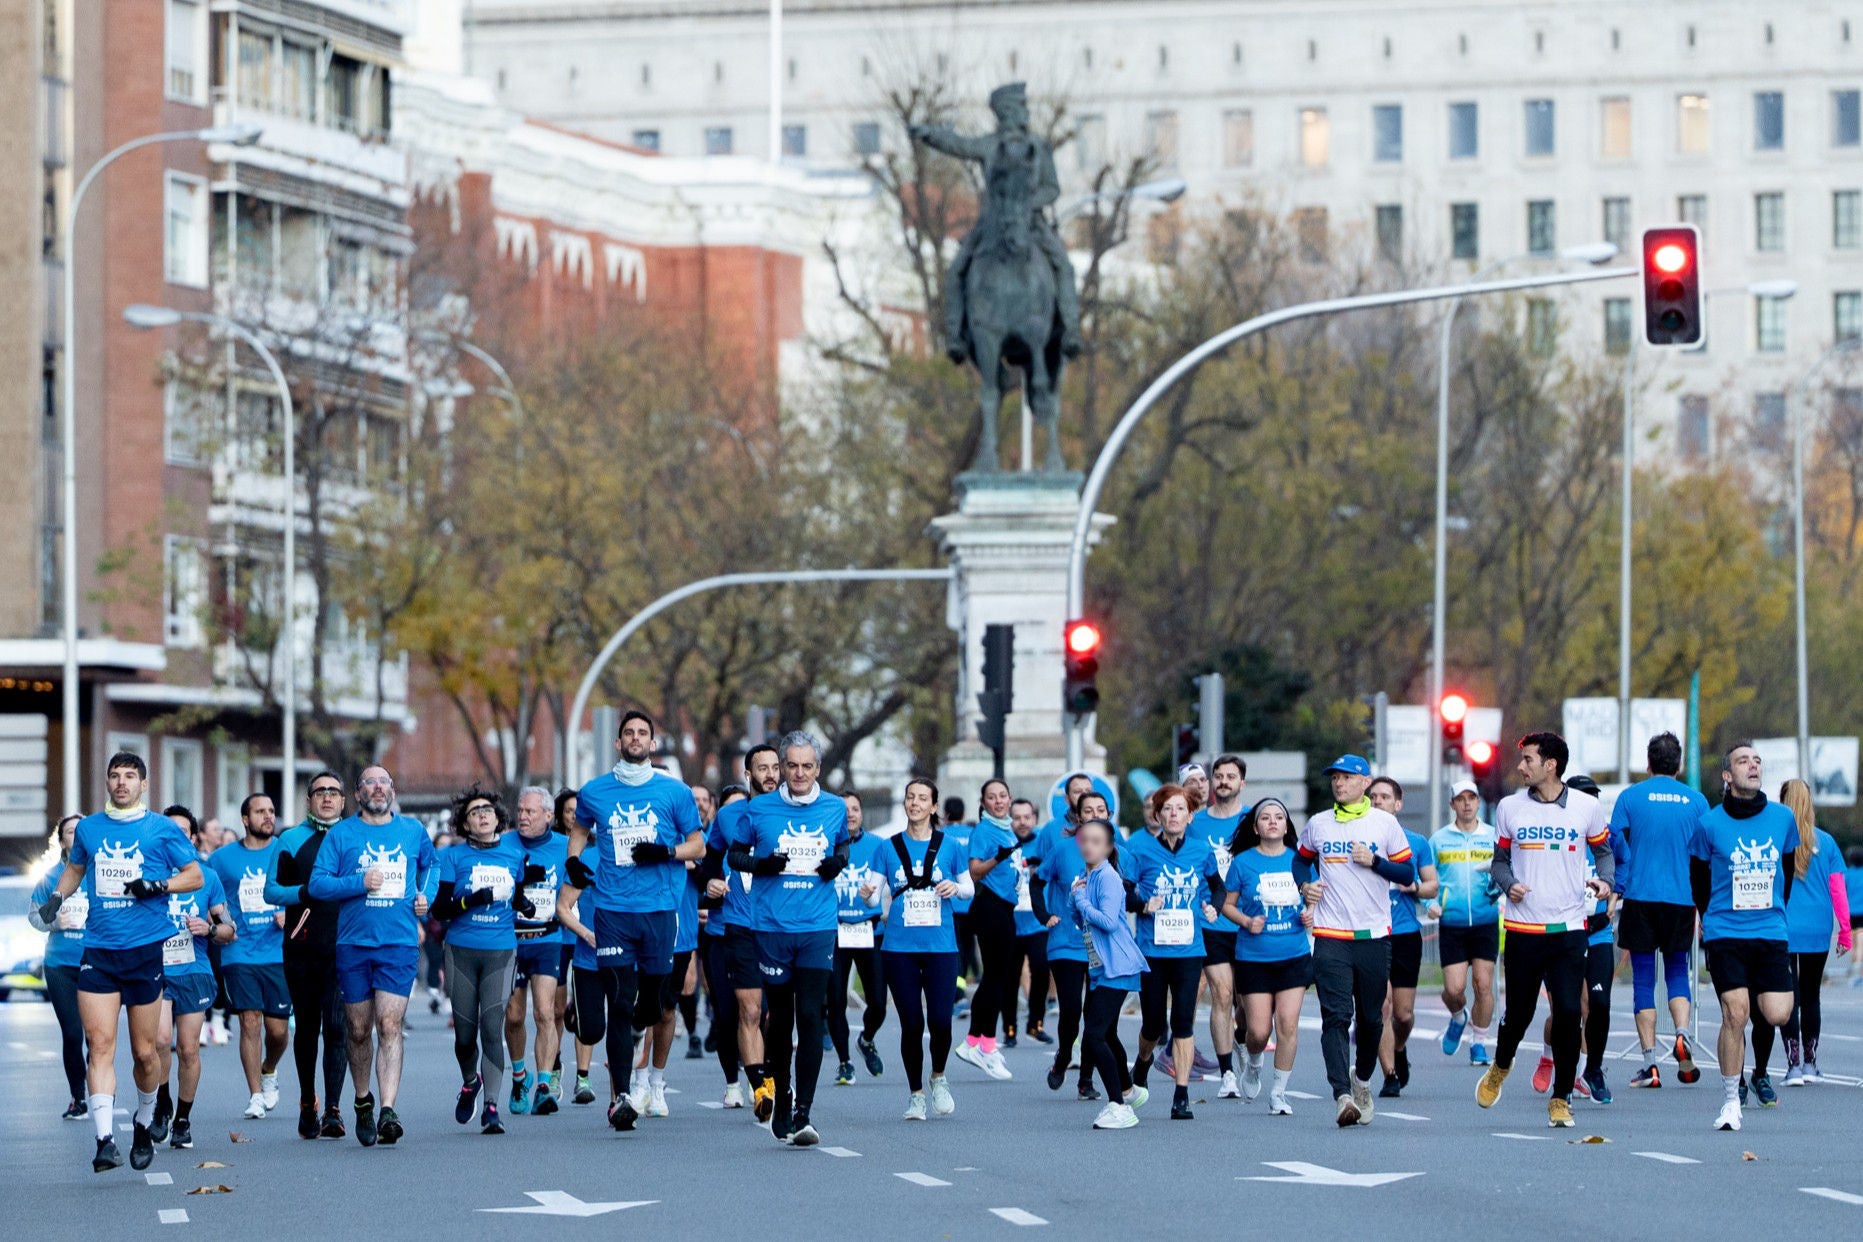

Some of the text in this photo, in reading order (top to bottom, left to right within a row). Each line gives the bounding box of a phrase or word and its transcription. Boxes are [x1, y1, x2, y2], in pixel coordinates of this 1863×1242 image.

[101, 868, 133, 878] 10296
[1739, 881, 1769, 891] 10298
[909, 900, 938, 909] 10343
[1161, 918, 1190, 927] 10289
